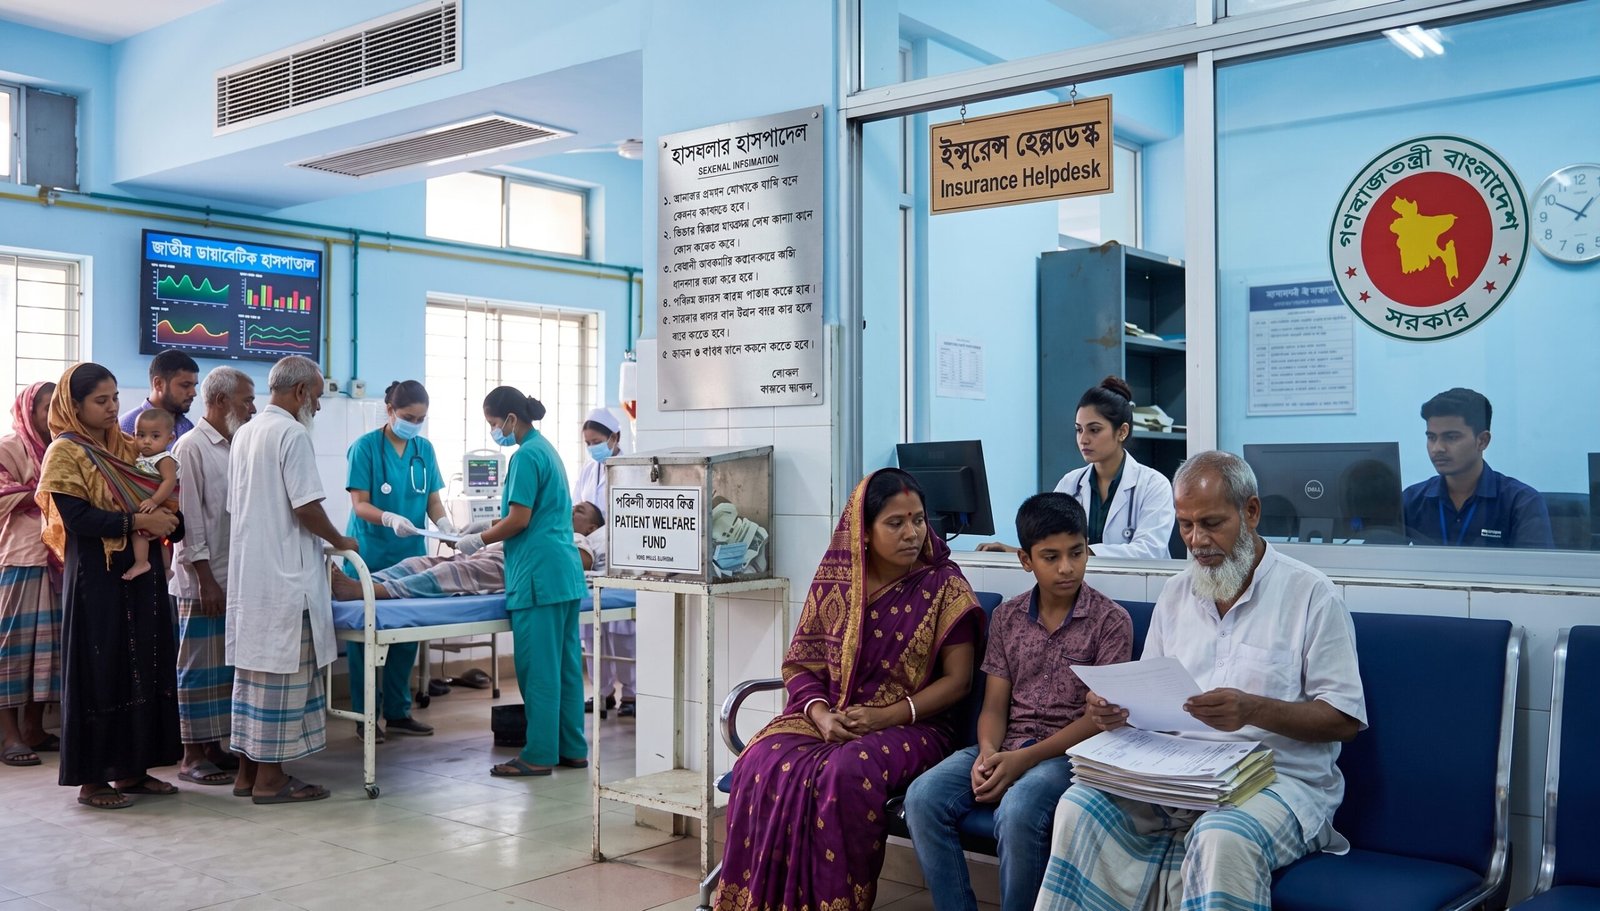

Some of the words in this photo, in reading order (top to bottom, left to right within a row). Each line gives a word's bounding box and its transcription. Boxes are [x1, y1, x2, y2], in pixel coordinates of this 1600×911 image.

[941, 173, 1018, 198] Insurance
[1022, 158, 1101, 189] Helpdesk
[1574, 174, 1586, 185] 12
[1443, 148, 1519, 231] বাংলাদেশ
[1544, 194, 1556, 206] 10
[1539, 211, 1547, 223] 9
[1545, 229, 1552, 240] 8
[1559, 240, 1567, 251] 7
[1576, 243, 1585, 255] 6
[151, 238, 193, 258] জাতীয়
[195, 246, 258, 266] ডায়াবেটিক
[260, 253, 316, 273] হাসপাতাল
[1384, 302, 1470, 332] সরকার
[1307, 486, 1321, 494] DELL
[615, 515, 650, 529] PATIENT
[652, 517, 696, 531] WELFARE
[642, 536, 666, 549] FUND
